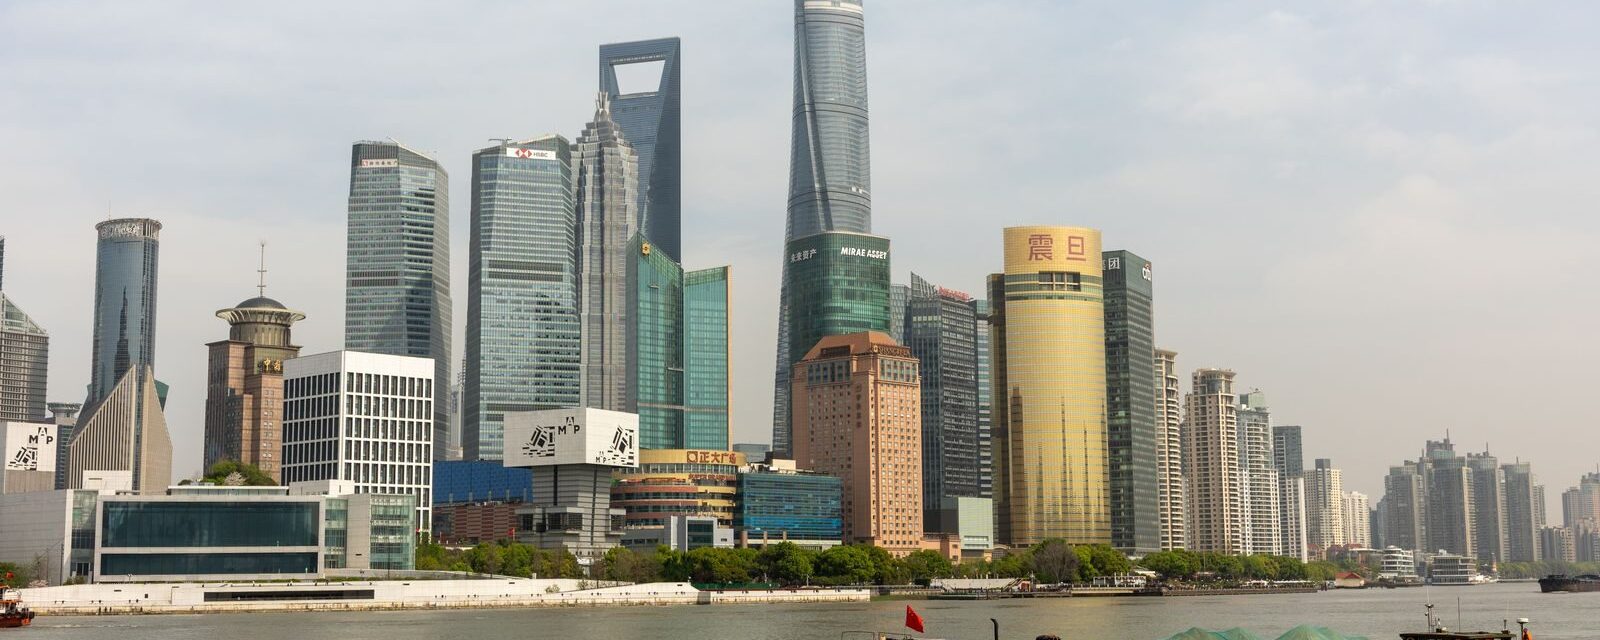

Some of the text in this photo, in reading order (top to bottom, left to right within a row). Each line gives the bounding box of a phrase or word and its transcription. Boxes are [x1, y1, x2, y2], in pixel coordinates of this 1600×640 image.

[791, 248, 817, 263] 未来资产
[841, 247, 888, 260] MIRAE ASSET
[1028, 234, 1086, 261] 震旦
[558, 416, 580, 435] MAP
[28, 427, 53, 444] MAP
[699, 451, 736, 464] 正大广场
